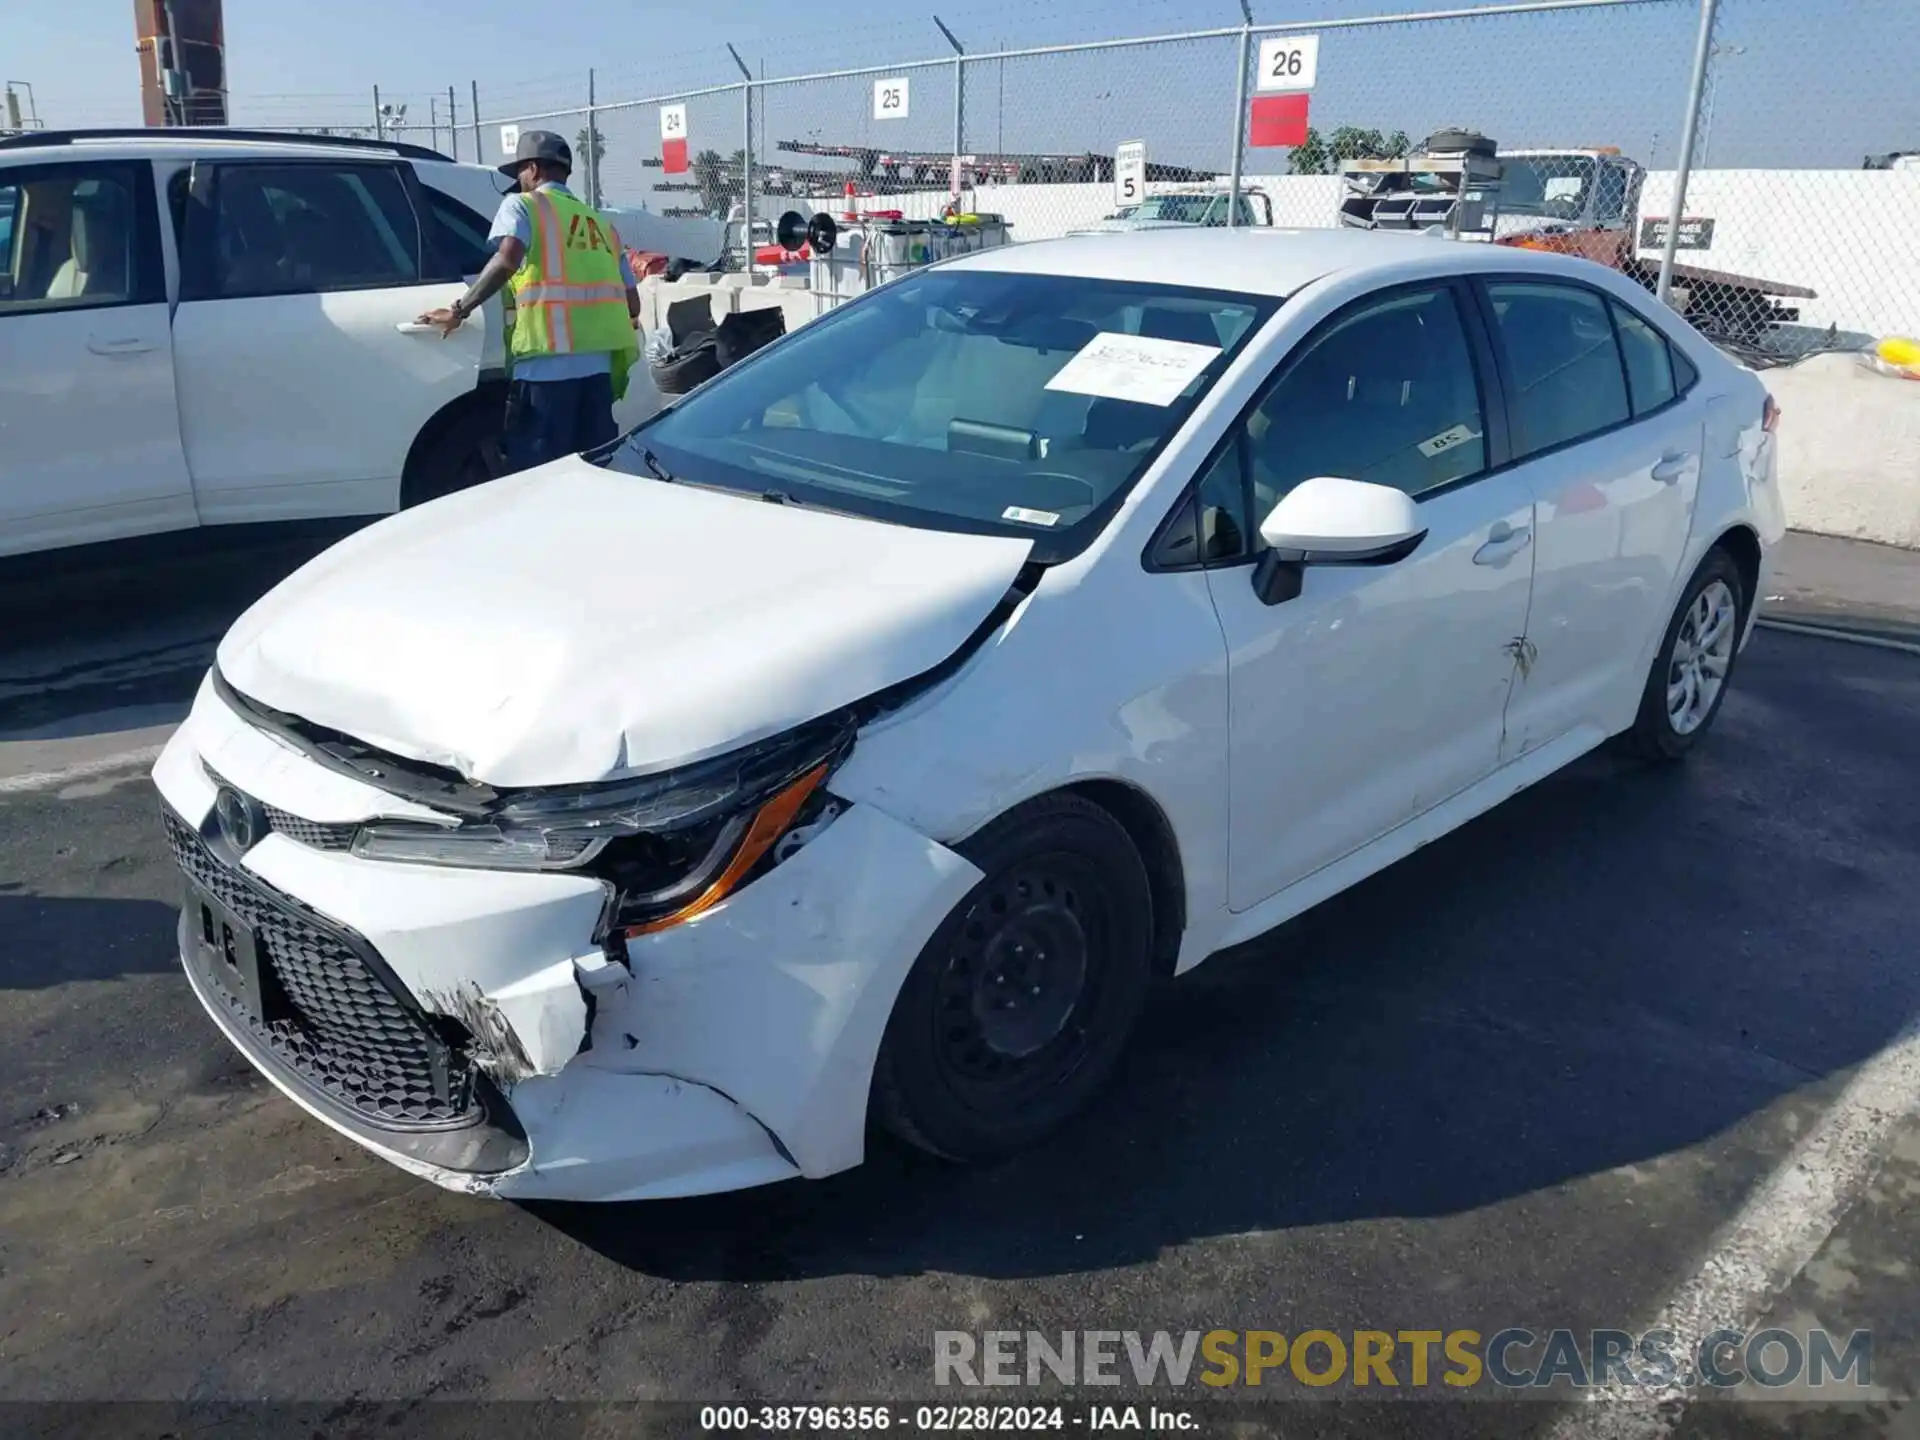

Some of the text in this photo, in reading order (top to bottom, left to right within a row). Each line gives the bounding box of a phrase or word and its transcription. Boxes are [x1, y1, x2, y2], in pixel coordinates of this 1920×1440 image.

[1272, 50, 1302, 76] 26
[882, 88, 901, 109] 25
[667, 113, 680, 131] 24
[1124, 177, 1136, 198] 5
